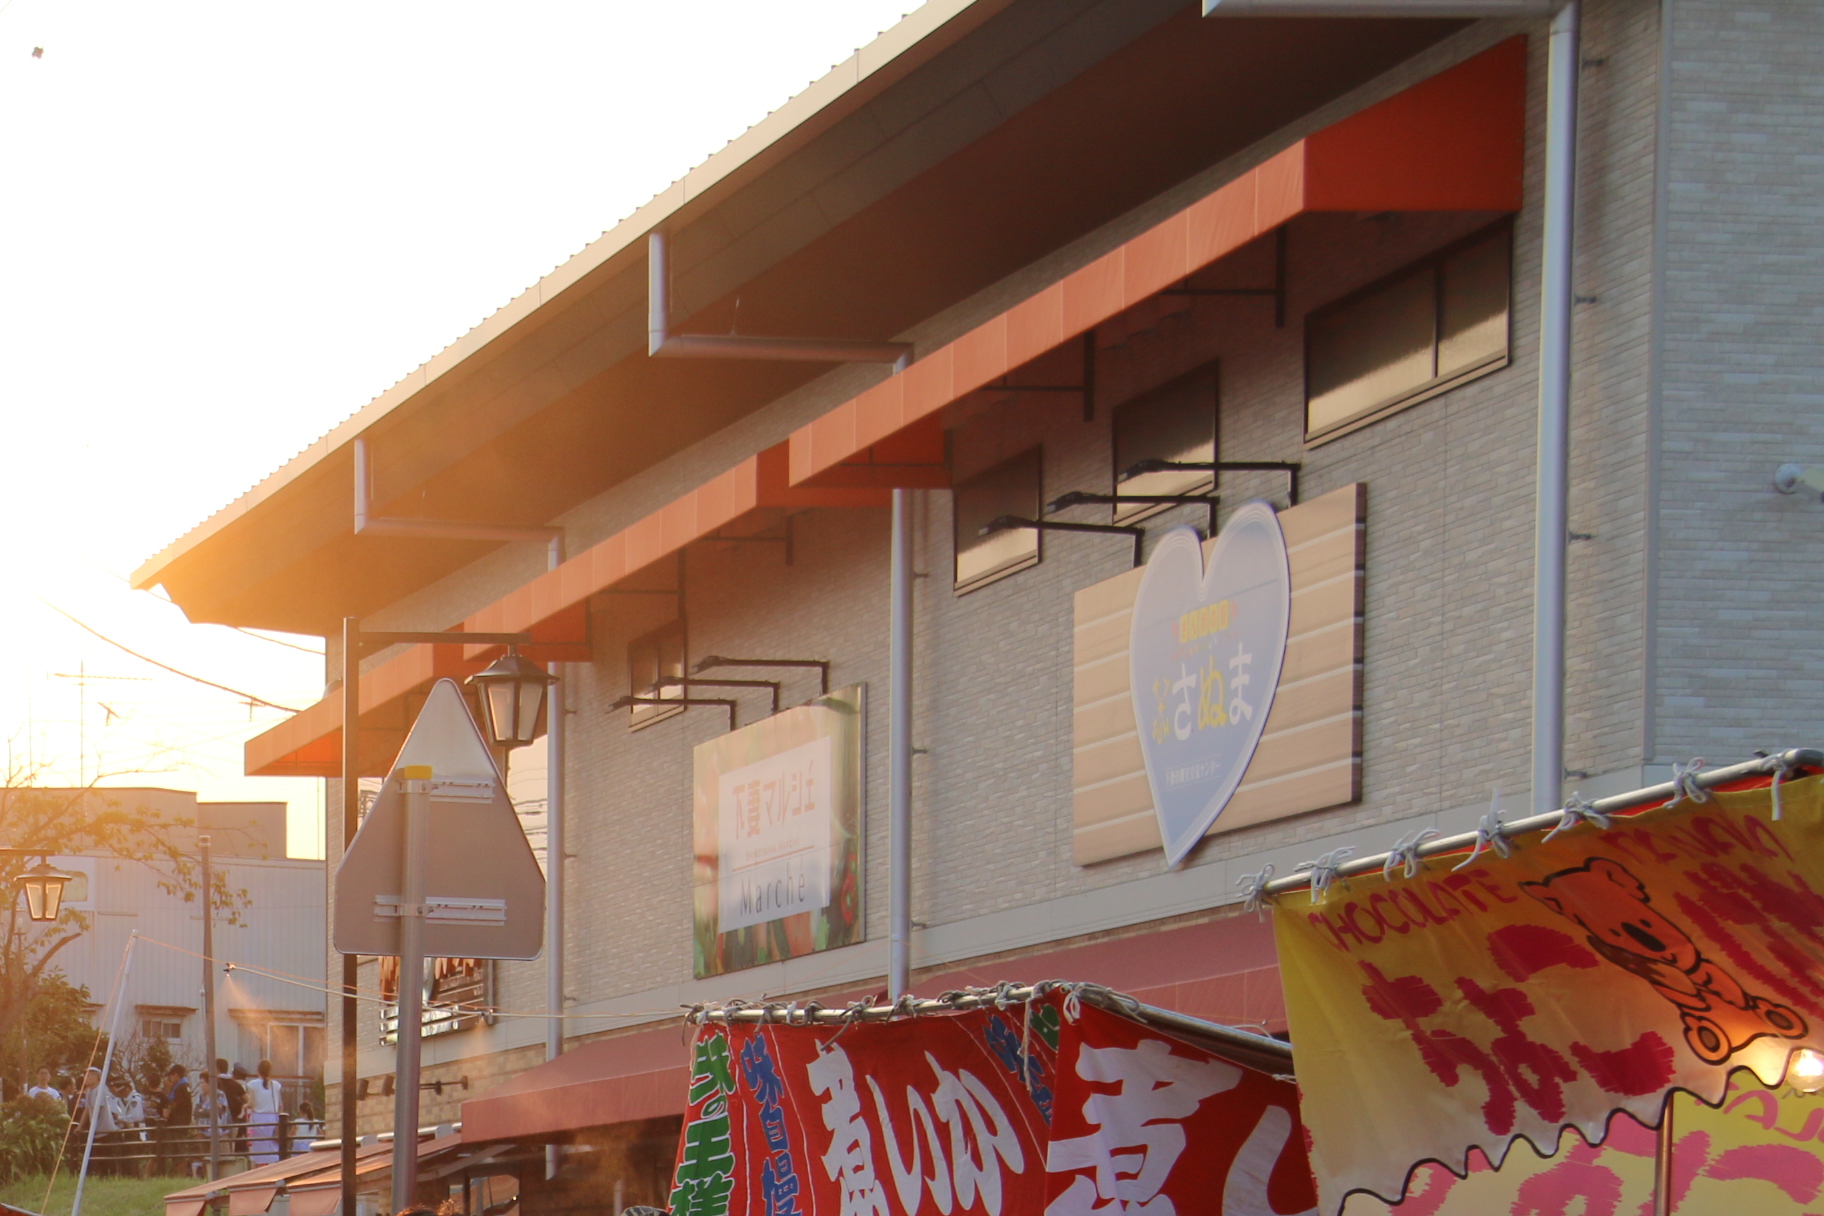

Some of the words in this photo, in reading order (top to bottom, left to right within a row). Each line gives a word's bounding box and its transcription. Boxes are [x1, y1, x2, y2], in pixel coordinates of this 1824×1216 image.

[1171, 642, 1253, 741] さぬま
[732, 759, 815, 841] 下妻マルシェ
[740, 855, 806, 918] Marché
[1307, 868, 1520, 953] CHOCOLATE
